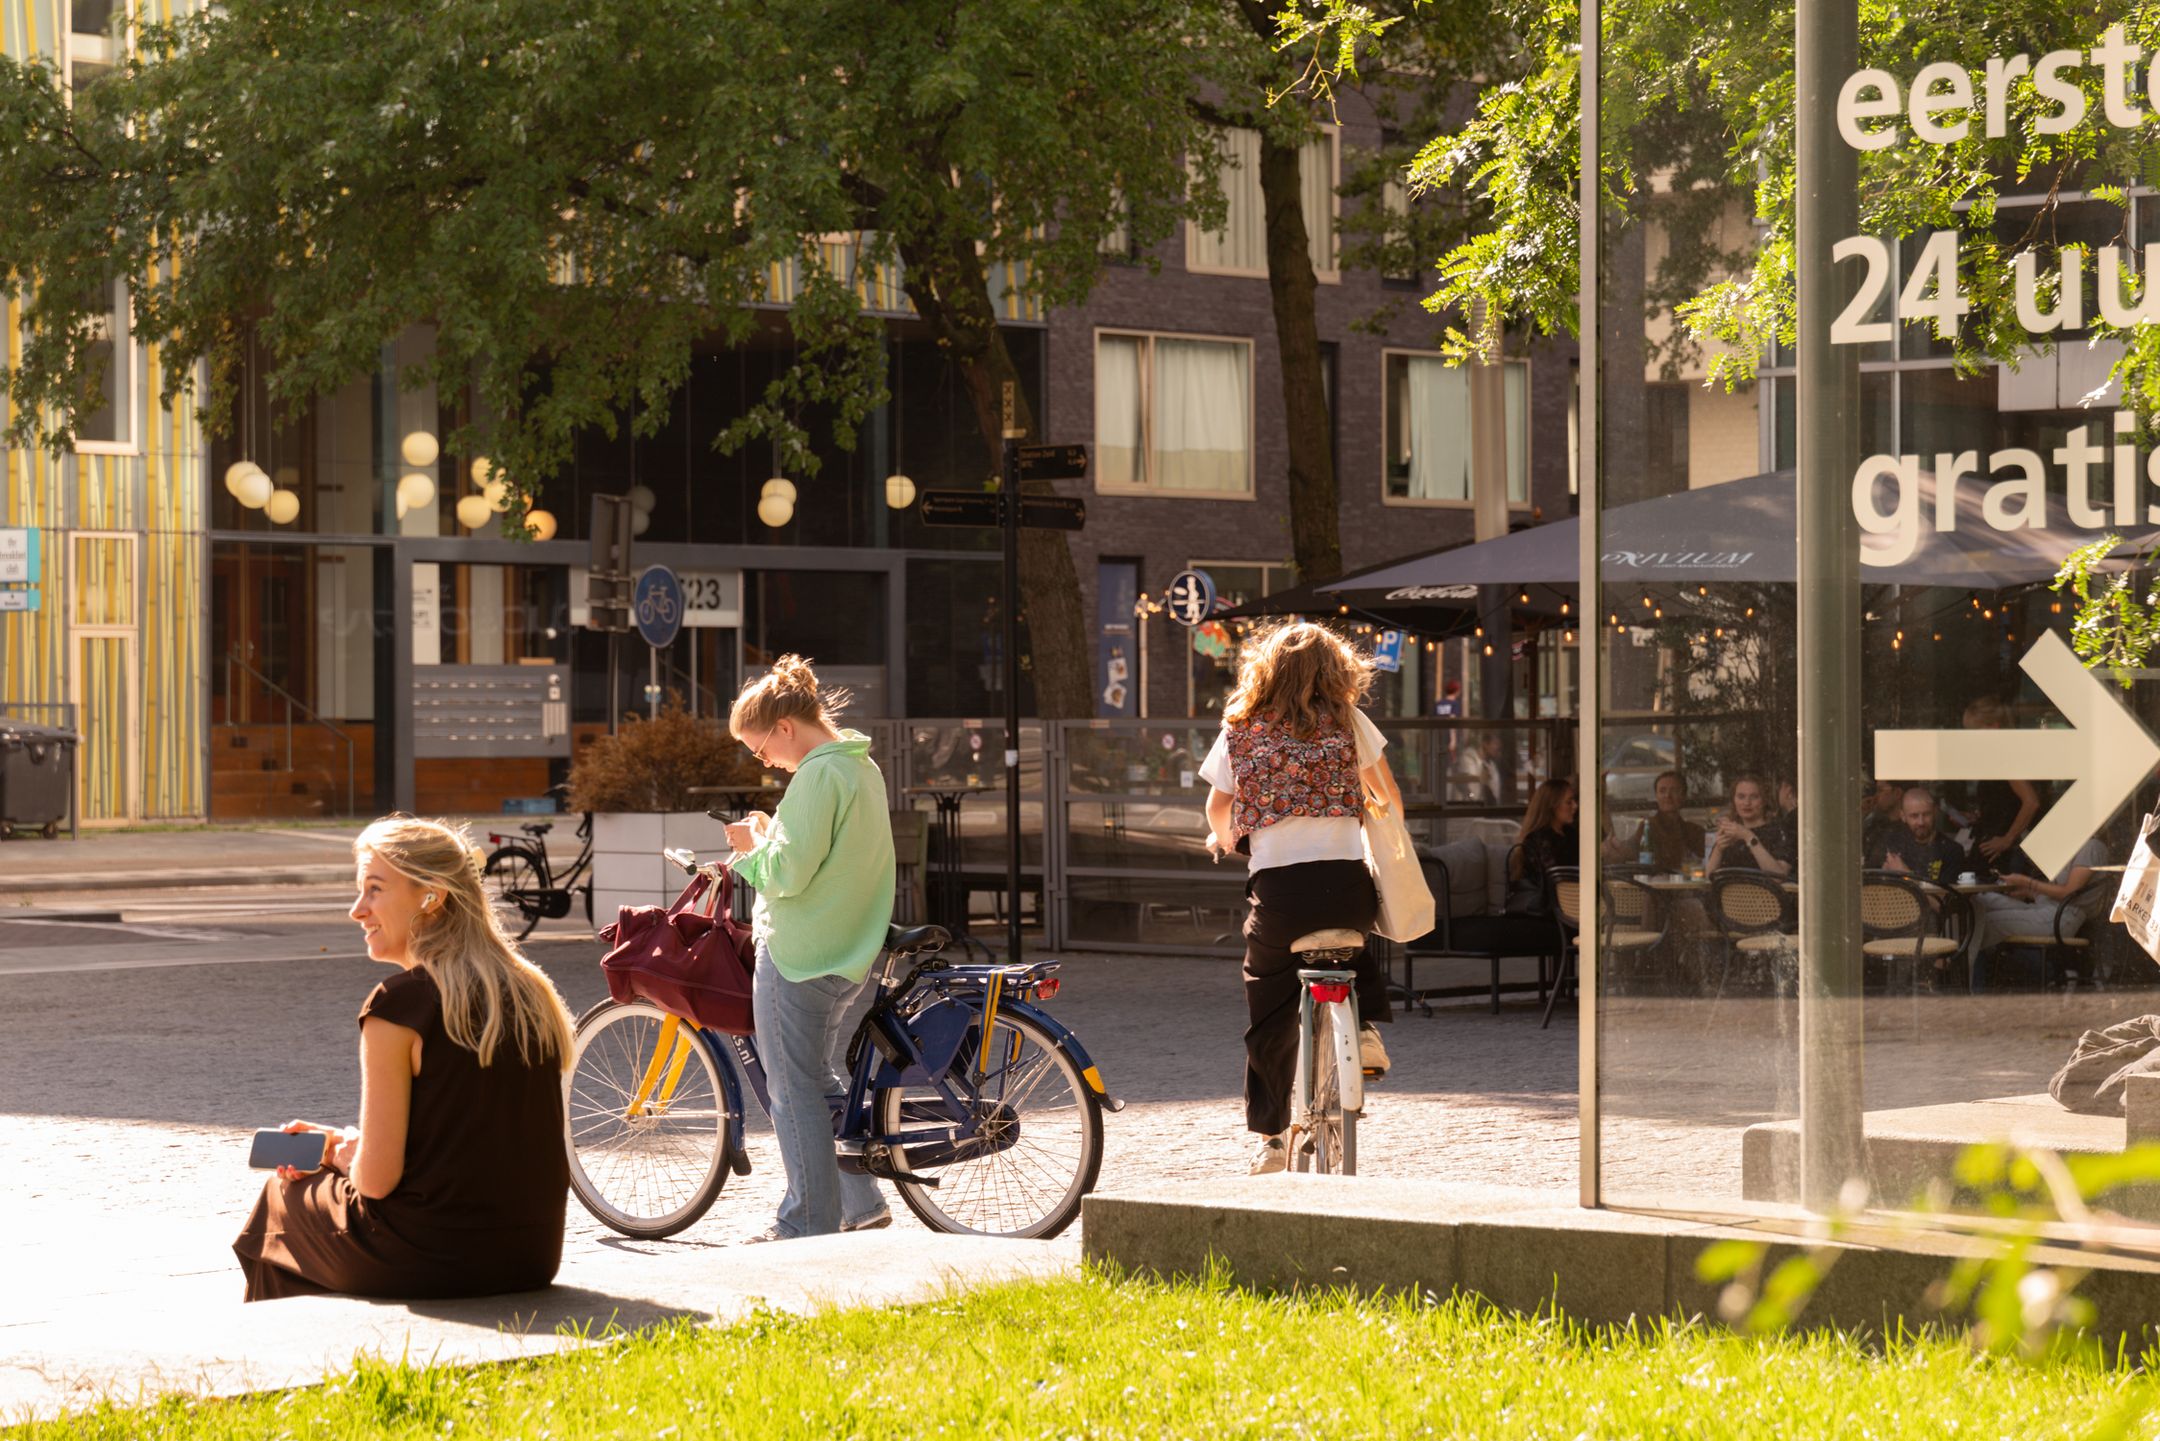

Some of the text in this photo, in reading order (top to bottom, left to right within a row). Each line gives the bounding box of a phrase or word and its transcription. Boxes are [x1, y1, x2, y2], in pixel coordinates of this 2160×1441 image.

[1837, 26, 2160, 151] eerst
[1830, 230, 1969, 345] 24
[1852, 411, 2160, 567] grati
